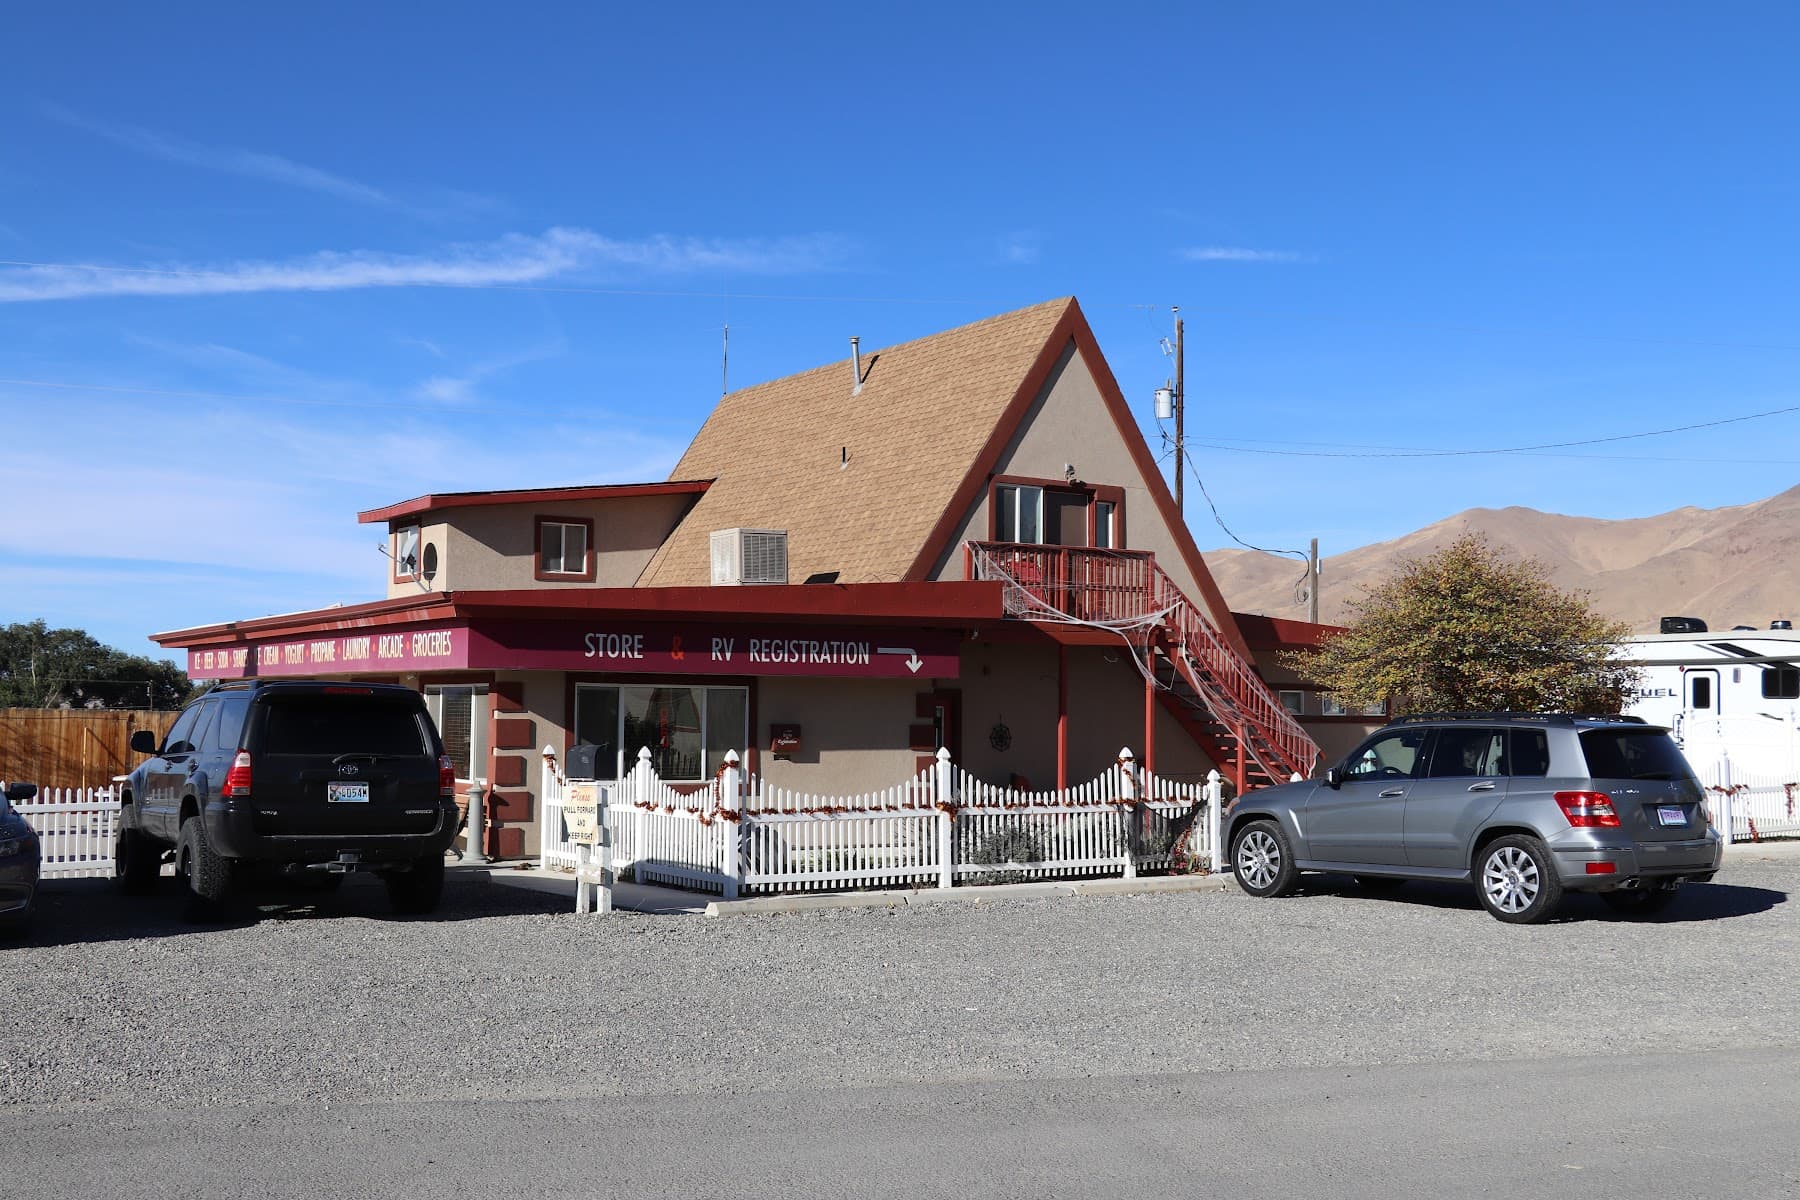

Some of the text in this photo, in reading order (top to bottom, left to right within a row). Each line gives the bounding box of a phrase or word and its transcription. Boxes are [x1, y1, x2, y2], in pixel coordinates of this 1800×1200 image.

[217, 651, 229, 669] SODA
[264, 646, 279, 665] CREAM
[285, 643, 305, 664] YOGURT
[310, 640, 335, 663] PROPANE
[342, 636, 371, 661] LAUNDRY
[378, 634, 404, 658] ARCADE
[412, 630, 452, 657] GROCERIES
[584, 633, 869, 664] STORE & RV REGISTRATION
[563, 806, 576, 814] PULL
